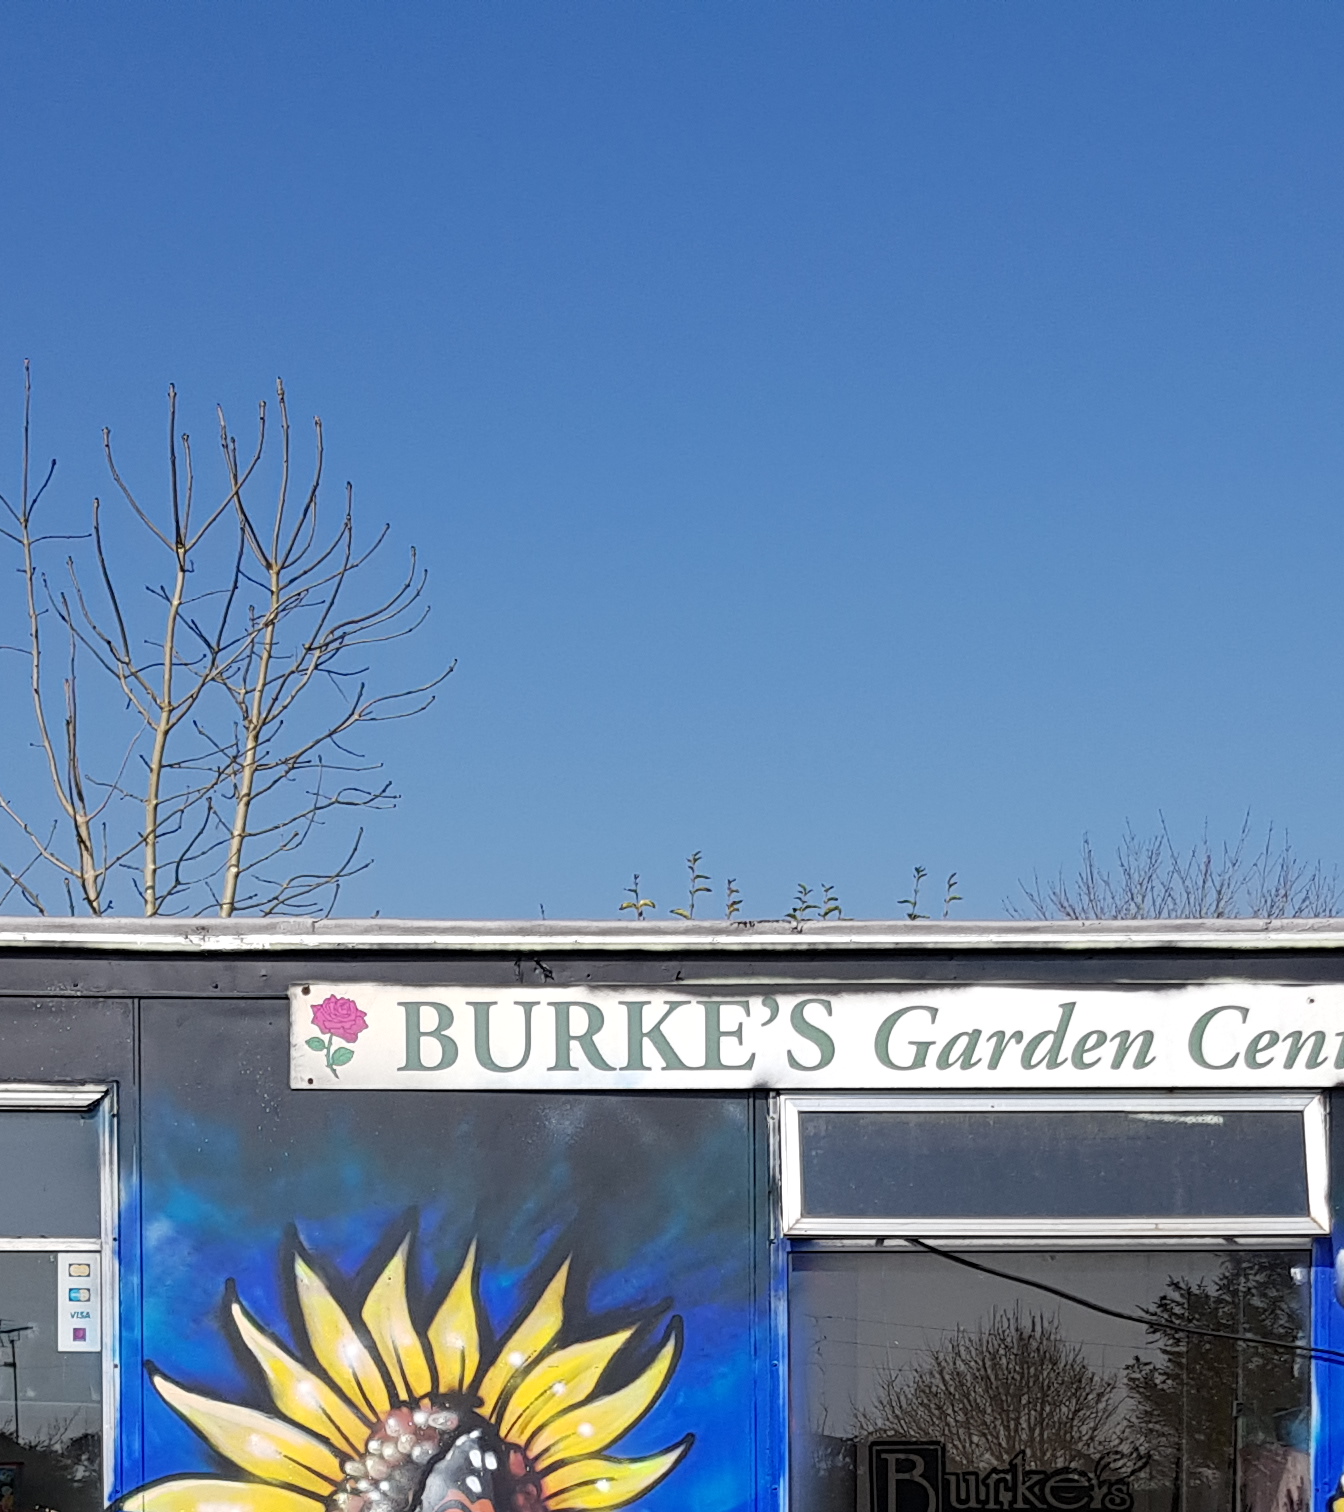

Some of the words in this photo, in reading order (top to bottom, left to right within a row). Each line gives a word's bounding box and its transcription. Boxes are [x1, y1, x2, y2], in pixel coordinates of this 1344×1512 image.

[396, 996, 837, 1073] BURKE'S
[873, 1001, 1156, 1072] Garden
[70, 1311, 91, 1319] VISA
